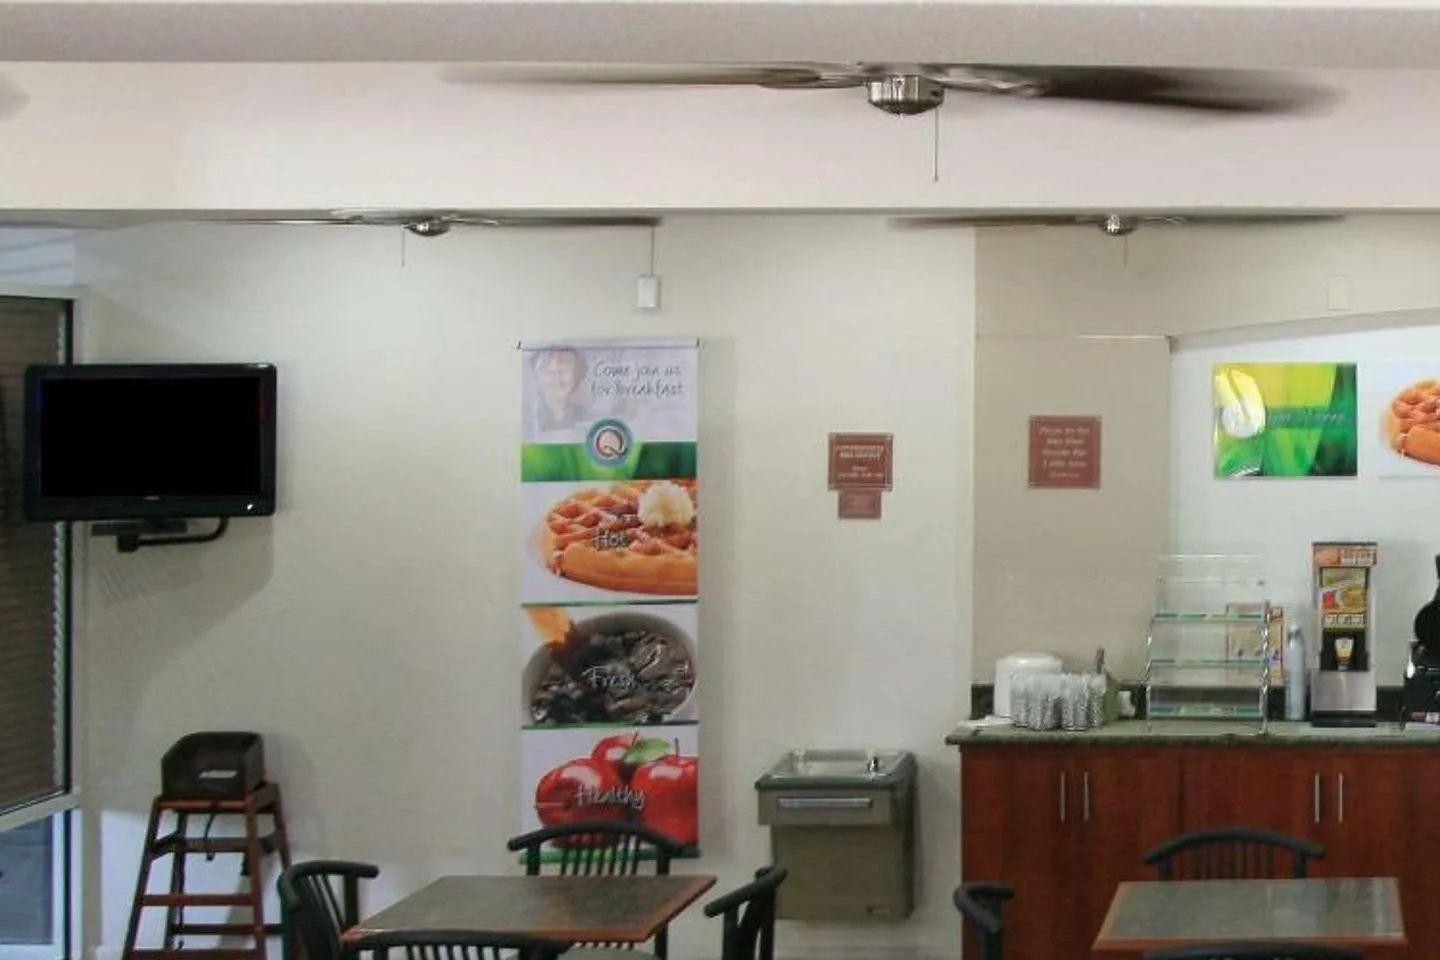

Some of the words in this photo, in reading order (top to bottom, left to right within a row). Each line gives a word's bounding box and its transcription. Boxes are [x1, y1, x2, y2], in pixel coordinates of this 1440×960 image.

[594, 360, 631, 378] Come
[633, 365, 659, 381] join
[590, 380, 611, 400] for
[573, 783, 646, 811] Healthy
